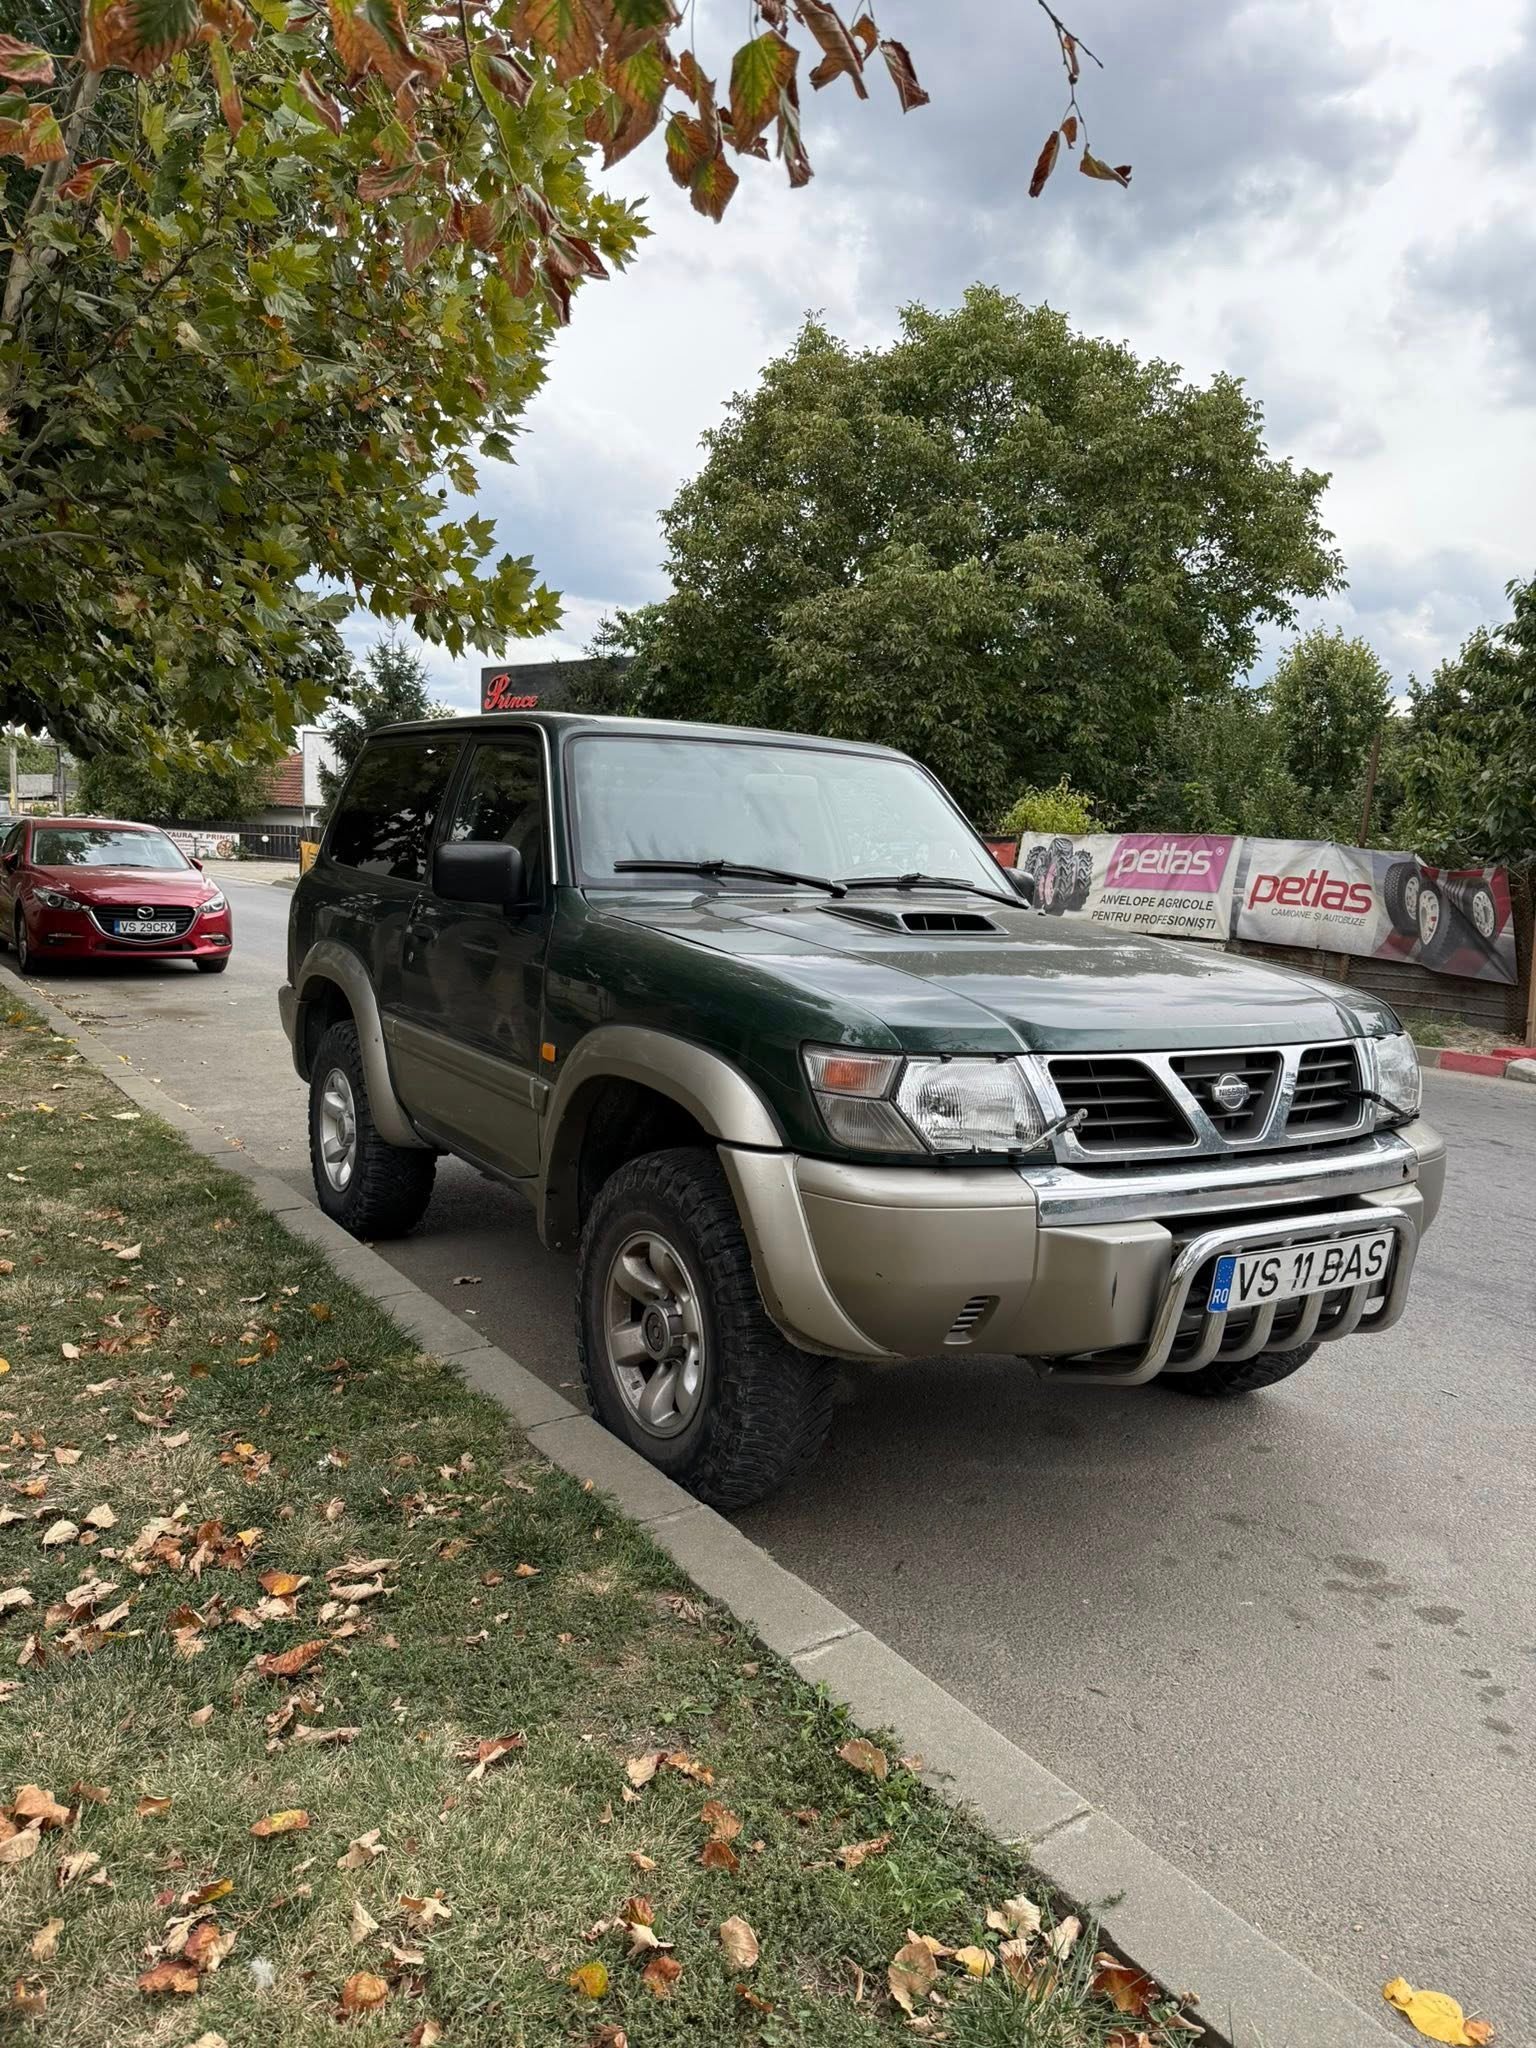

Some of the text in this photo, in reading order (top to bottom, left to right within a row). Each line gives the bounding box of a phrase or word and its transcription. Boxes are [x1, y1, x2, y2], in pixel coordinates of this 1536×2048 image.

[484, 673, 538, 710] Prince
[1113, 842, 1213, 879] petlas
[1248, 869, 1372, 914] petlas
[1100, 894, 1214, 911] ANVELOPE AGRICOLE
[1091, 910, 1132, 923] PENTRU
[1322, 914, 1367, 927] AUTOBUZE
[121, 922, 175, 932] VS 29CRX
[1239, 1239, 1386, 1301] VS 11 BAS
[1212, 1287, 1229, 1304] RO
